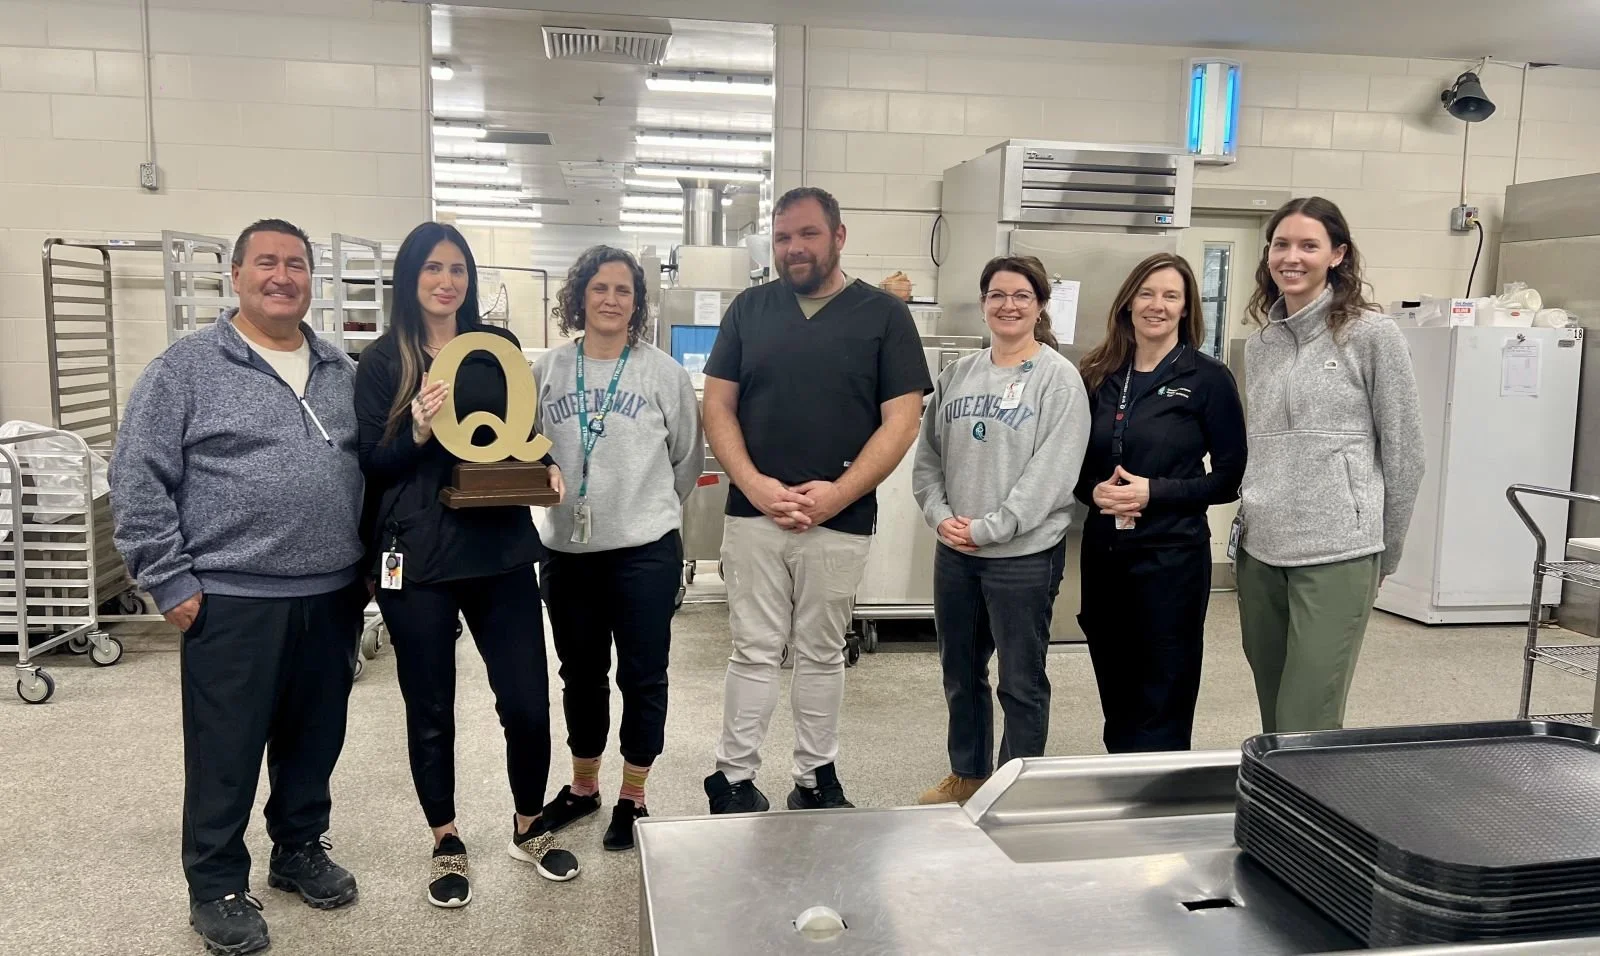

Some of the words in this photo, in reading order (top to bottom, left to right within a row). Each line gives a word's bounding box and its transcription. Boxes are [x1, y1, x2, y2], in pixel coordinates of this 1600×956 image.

[1574, 328, 1583, 339] 18
[612, 359, 625, 380] STRONG
[427, 331, 553, 463] Q
[578, 390, 586, 413] STRONG
[587, 431, 597, 450] STRON
